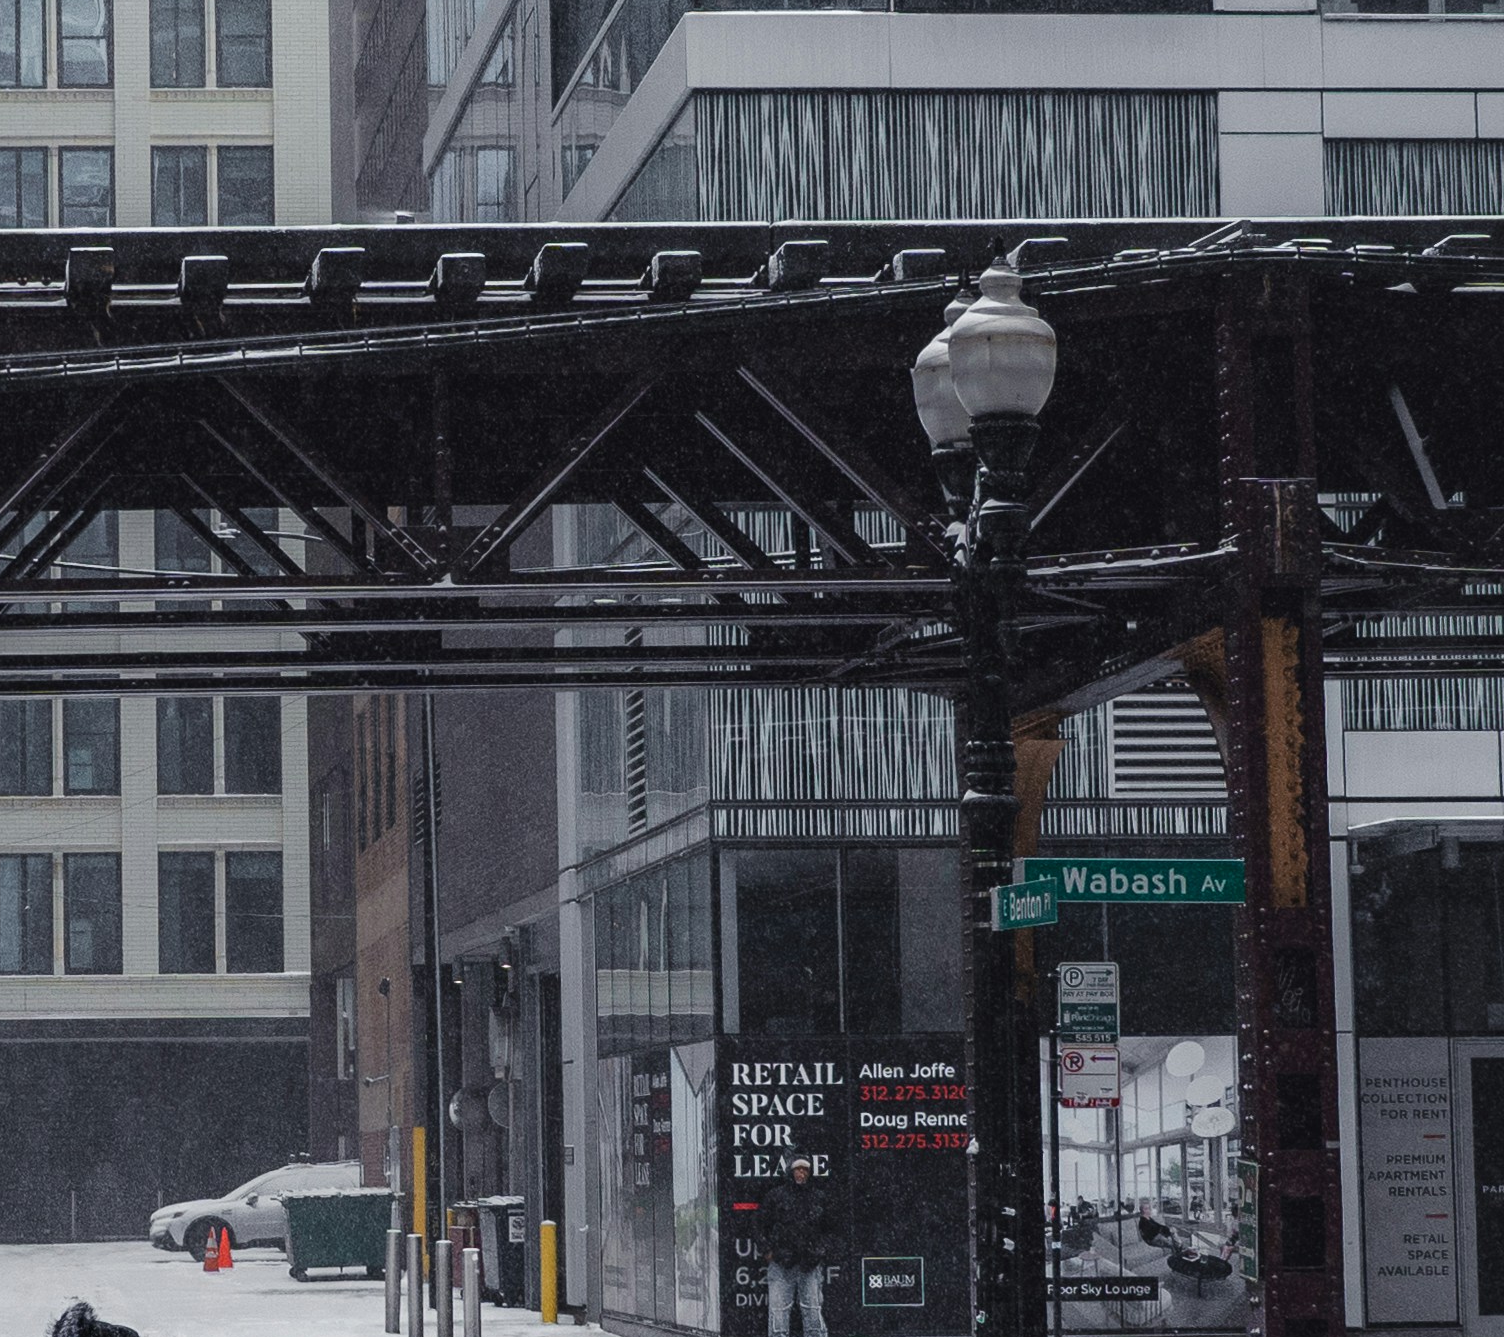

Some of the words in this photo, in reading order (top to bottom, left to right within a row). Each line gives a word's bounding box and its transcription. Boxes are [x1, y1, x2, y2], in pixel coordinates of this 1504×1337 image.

[1062, 867, 1188, 894] Wabash
[1202, 875, 1227, 892] Av
[1010, 890, 1043, 921] Benton
[732, 1062, 843, 1085] RETAIL
[858, 1063, 903, 1079] Allen
[910, 1063, 955, 1079] Joffe
[1365, 1077, 1447, 1088] PENTHOUSE
[1361, 1093, 1448, 1104] COLLECTION
[732, 1093, 825, 1116] SPACE
[1380, 1110, 1408, 1120] FOR
[1412, 1109, 1448, 1120] RENT
[860, 1113, 907, 1129] Doug
[733, 1124, 793, 1147] FOR
[1386, 1154, 1446, 1165] PREMIUM
[733, 1154, 829, 1178] LEAE
[1367, 1170, 1446, 1181] APARTMENT
[1387, 1186, 1448, 1197] RENTALS
[1403, 1234, 1449, 1244] RETAIL
[1407, 1250, 1449, 1260] SPACE
[1377, 1266, 1450, 1276] AVAILABLE
[883, 1274, 915, 1284] BAUM
[1080, 1283, 1102, 1296] Sky
[1104, 1283, 1152, 1296] Lounge
